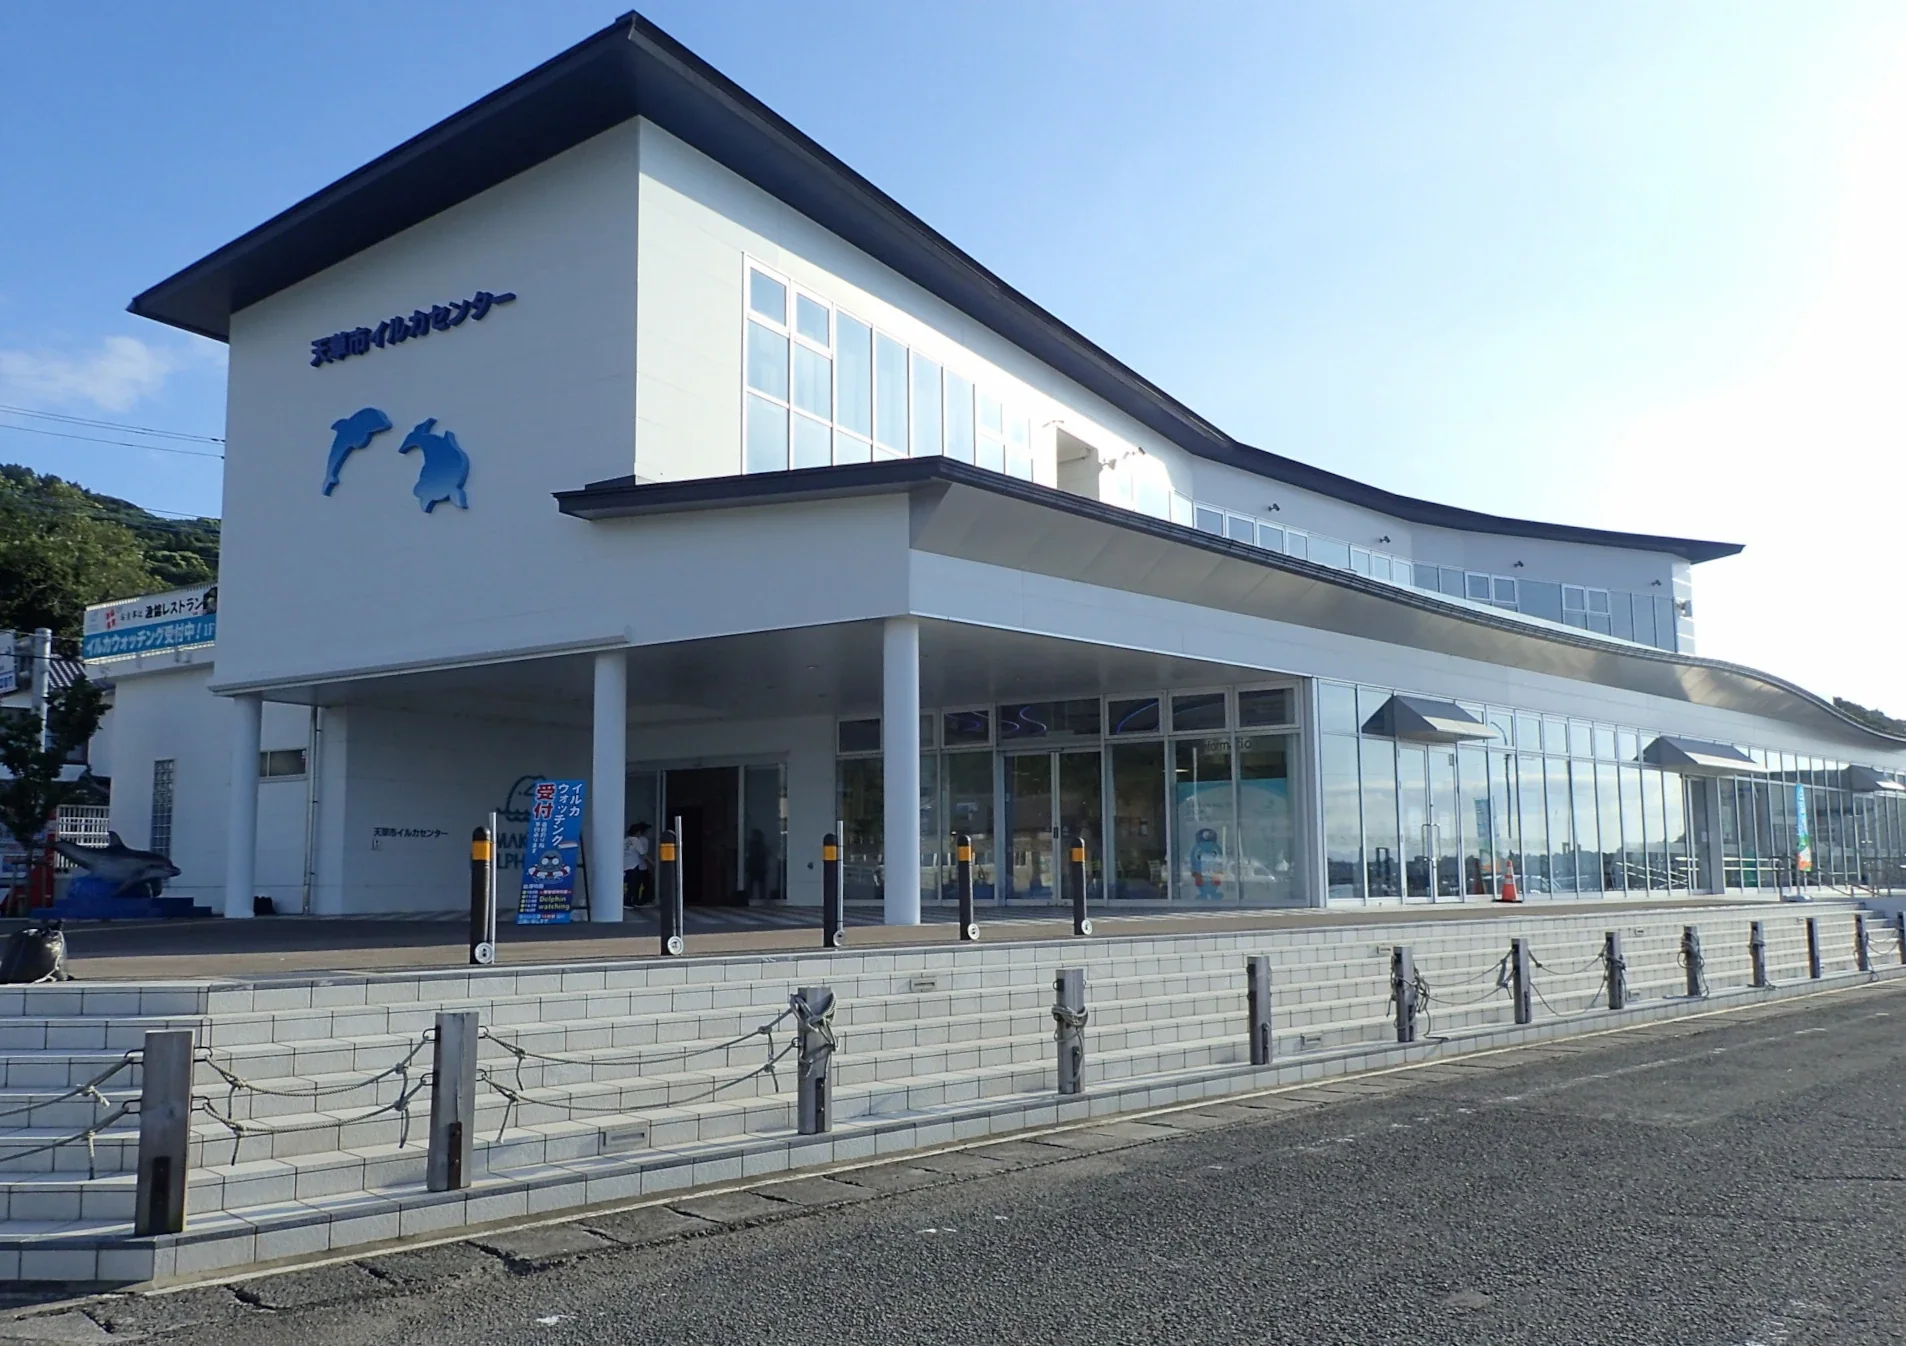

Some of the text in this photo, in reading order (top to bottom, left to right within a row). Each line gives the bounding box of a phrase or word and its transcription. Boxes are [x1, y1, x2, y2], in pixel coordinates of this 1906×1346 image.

[310, 291, 516, 368] 天草市イルカセンター
[533, 782, 556, 820] 受付
[569, 783, 584, 817] イルカ
[373, 827, 448, 838] 天草市イルカセンター
